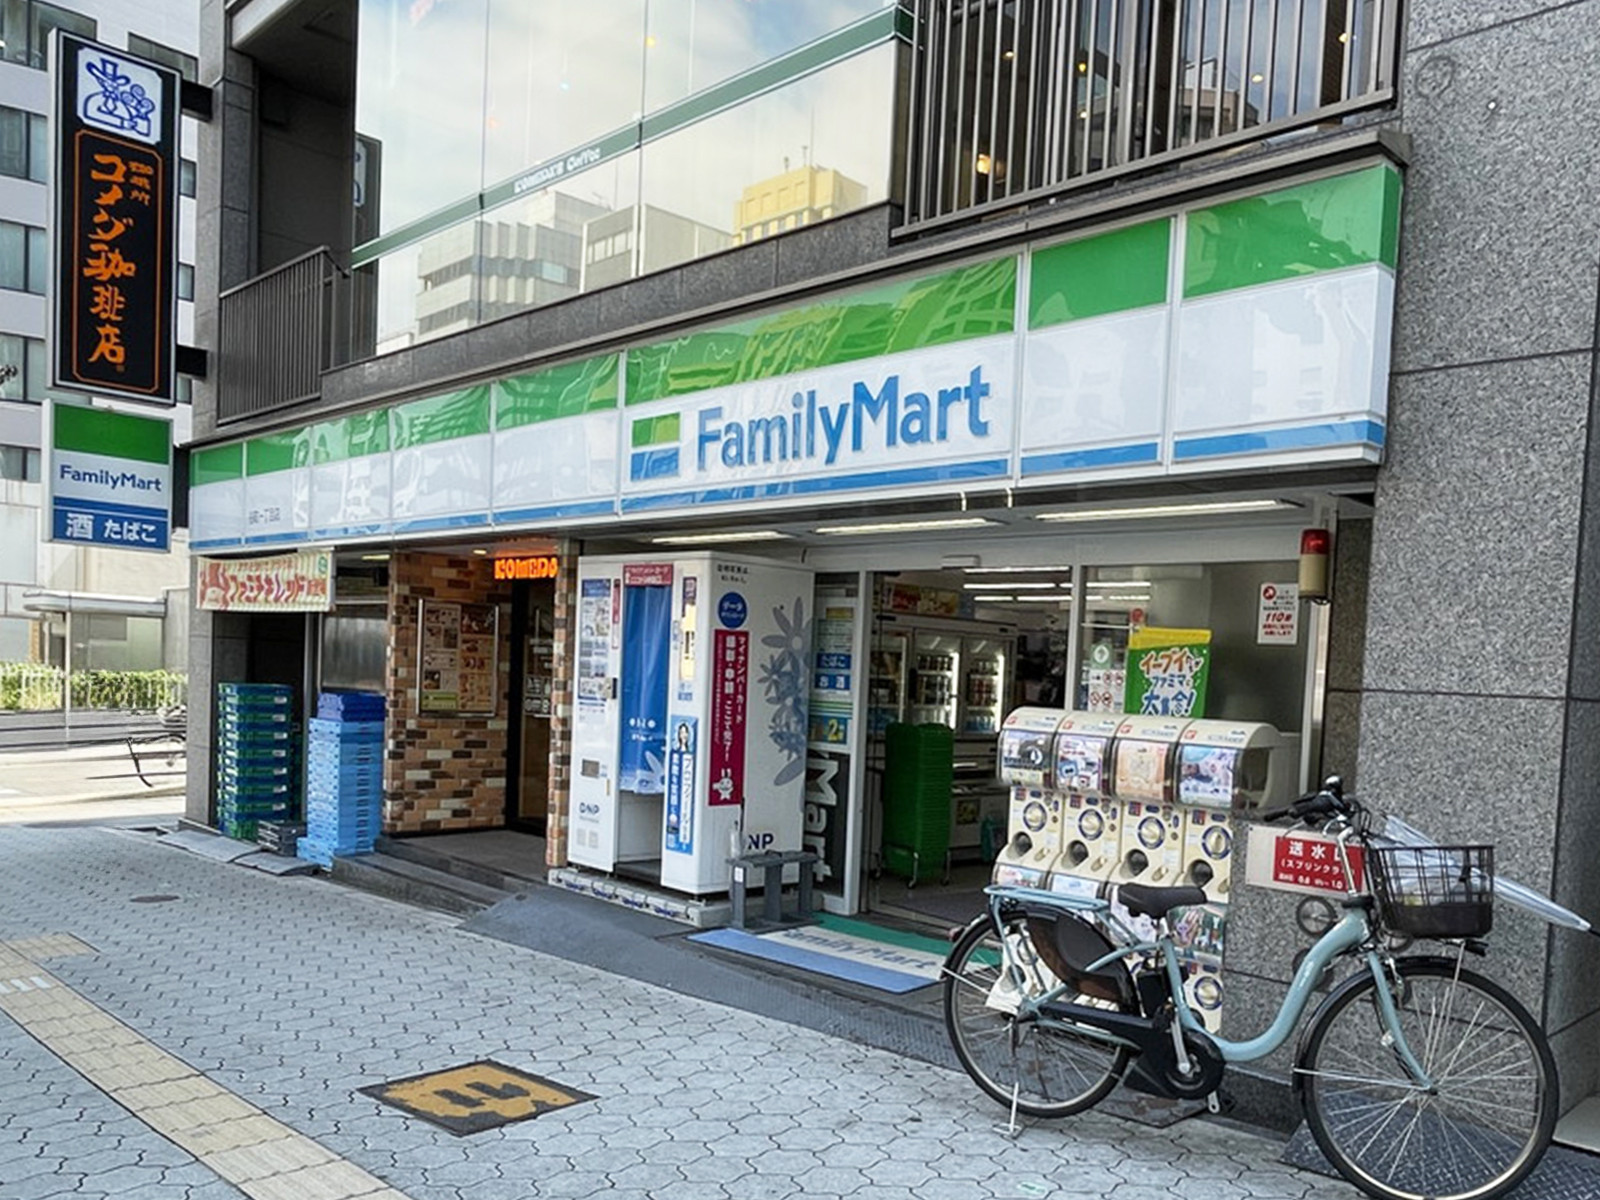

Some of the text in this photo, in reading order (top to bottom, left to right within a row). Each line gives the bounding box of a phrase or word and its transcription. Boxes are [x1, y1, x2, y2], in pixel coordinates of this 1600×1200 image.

[698, 365, 991, 472] FamilyMart
[60, 464, 162, 492] FamilyMart
[66, 512, 157, 543] 酒 たばこ
